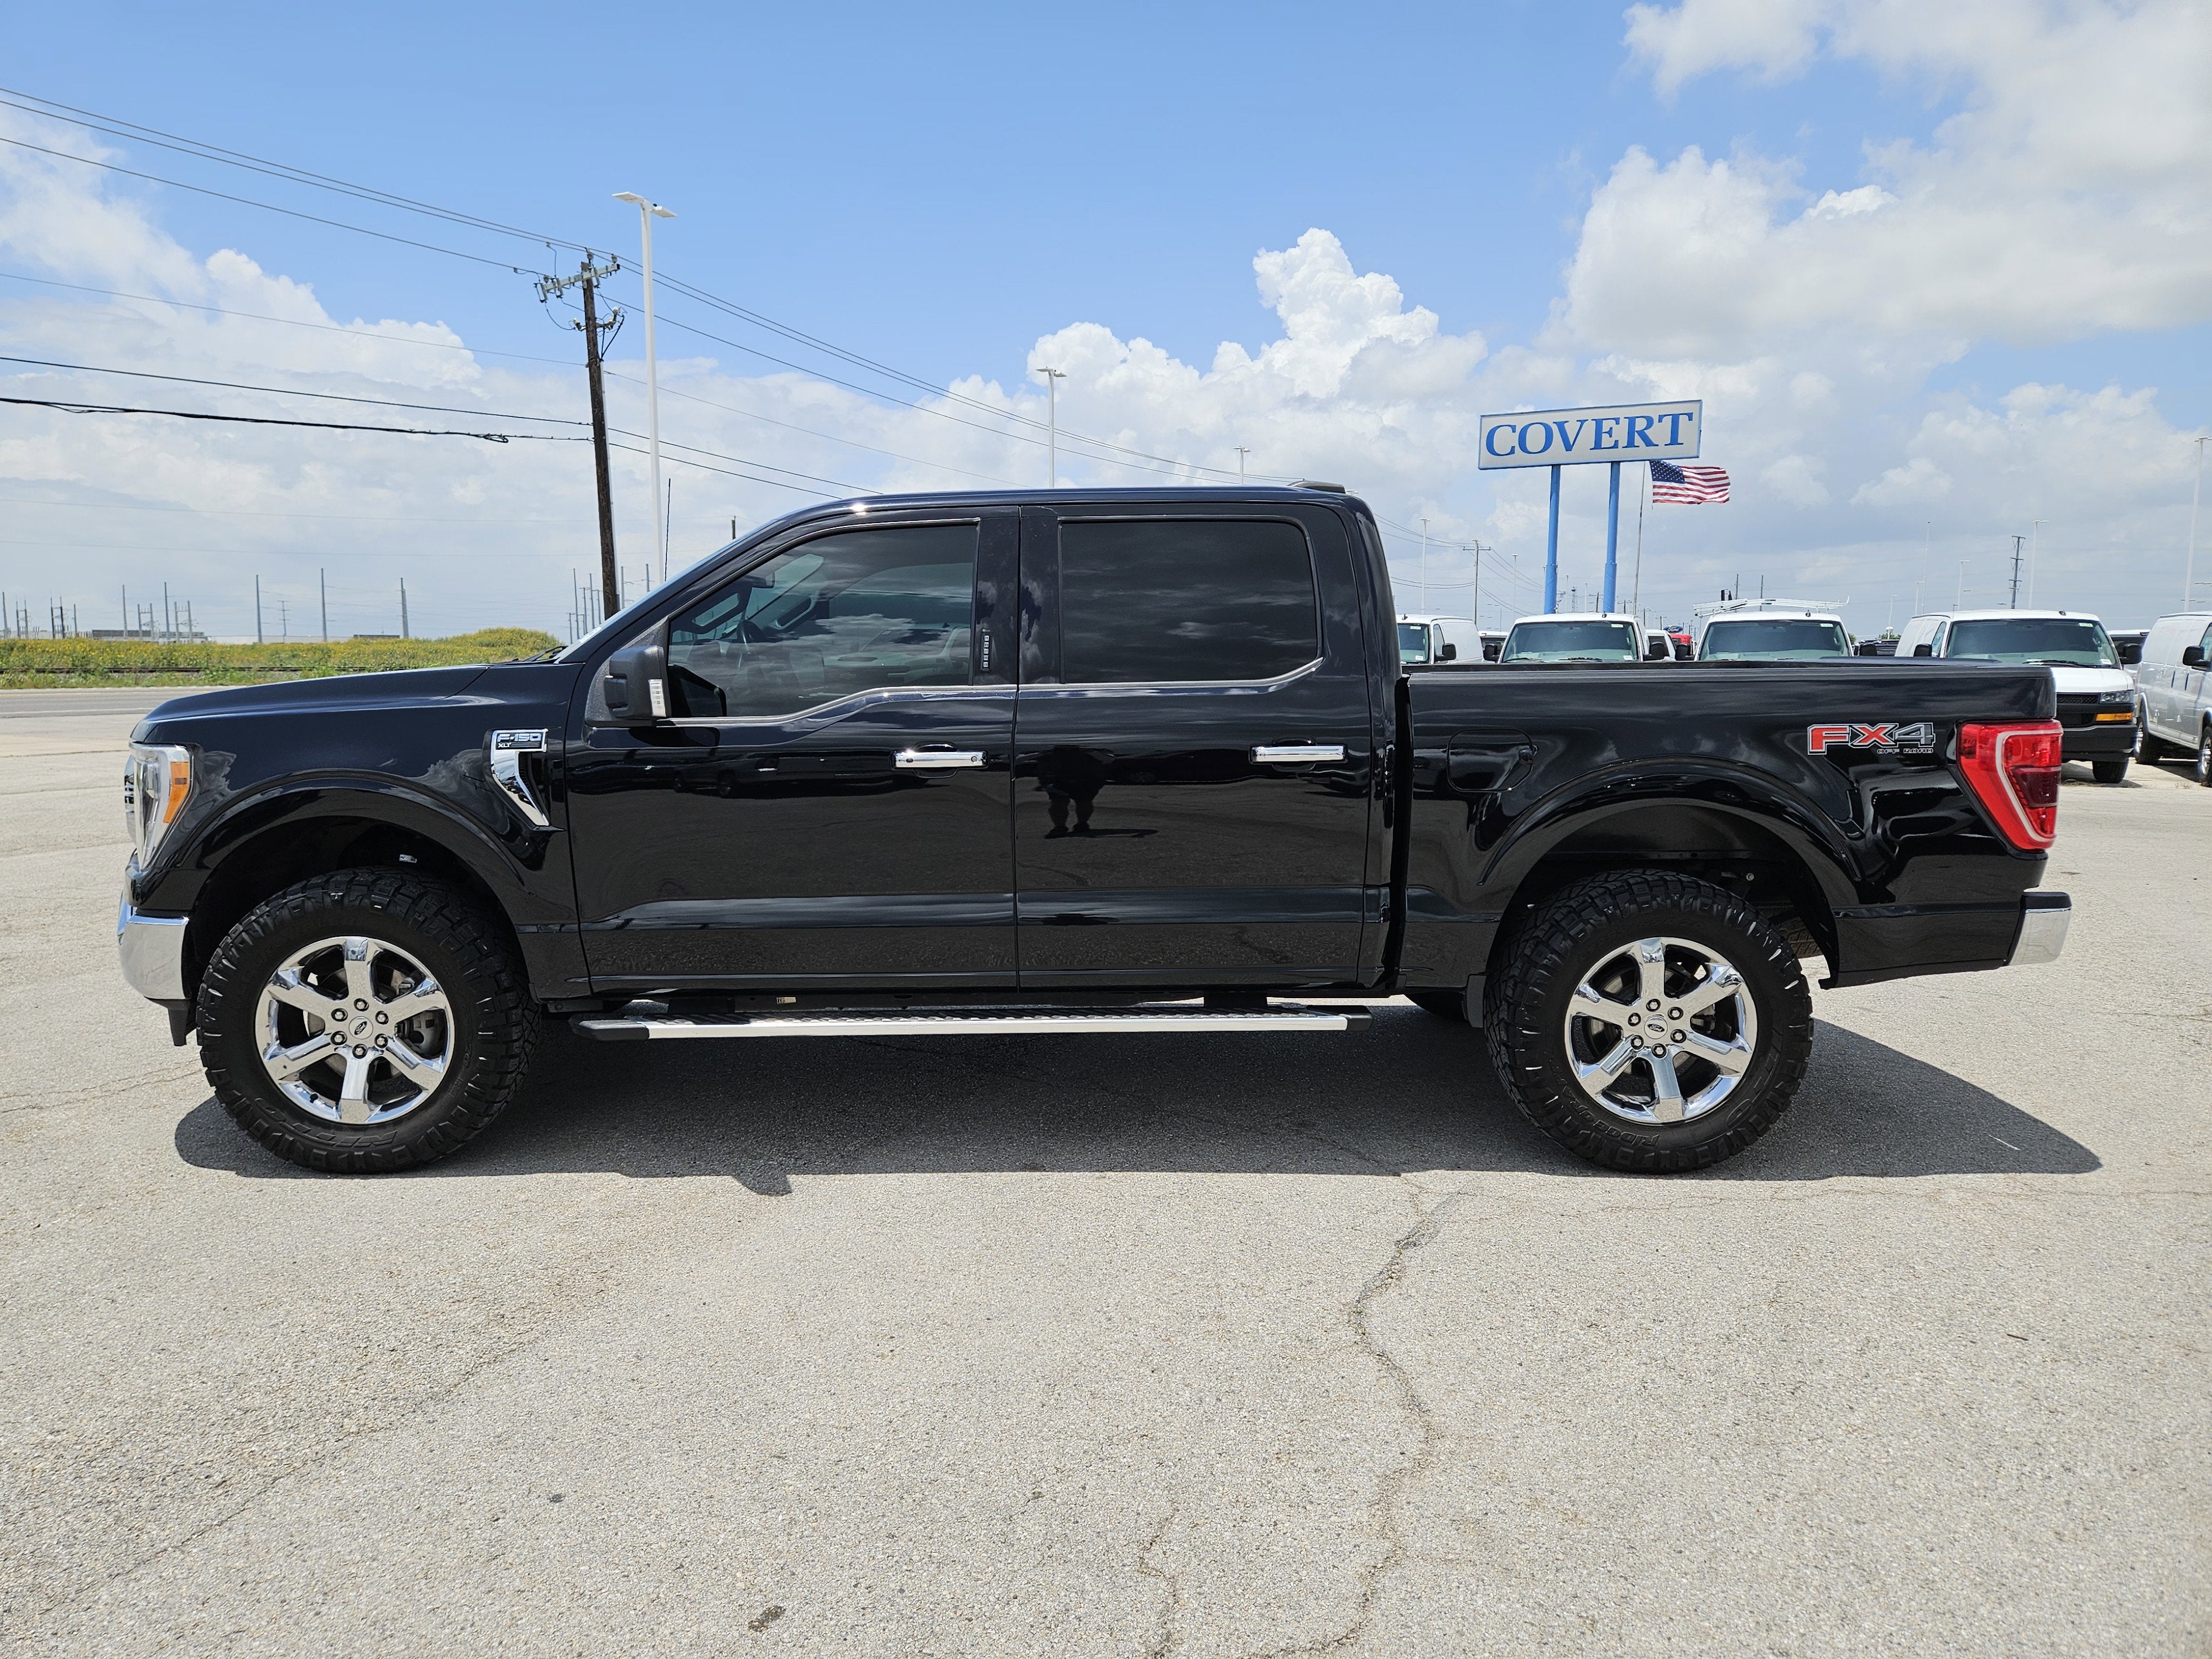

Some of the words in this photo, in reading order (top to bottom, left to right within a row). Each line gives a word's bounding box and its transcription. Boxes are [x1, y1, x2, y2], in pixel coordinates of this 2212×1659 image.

[1485, 413, 1693, 456] COVERT
[497, 733, 541, 742] F-150
[1807, 723, 1935, 755] FX4
